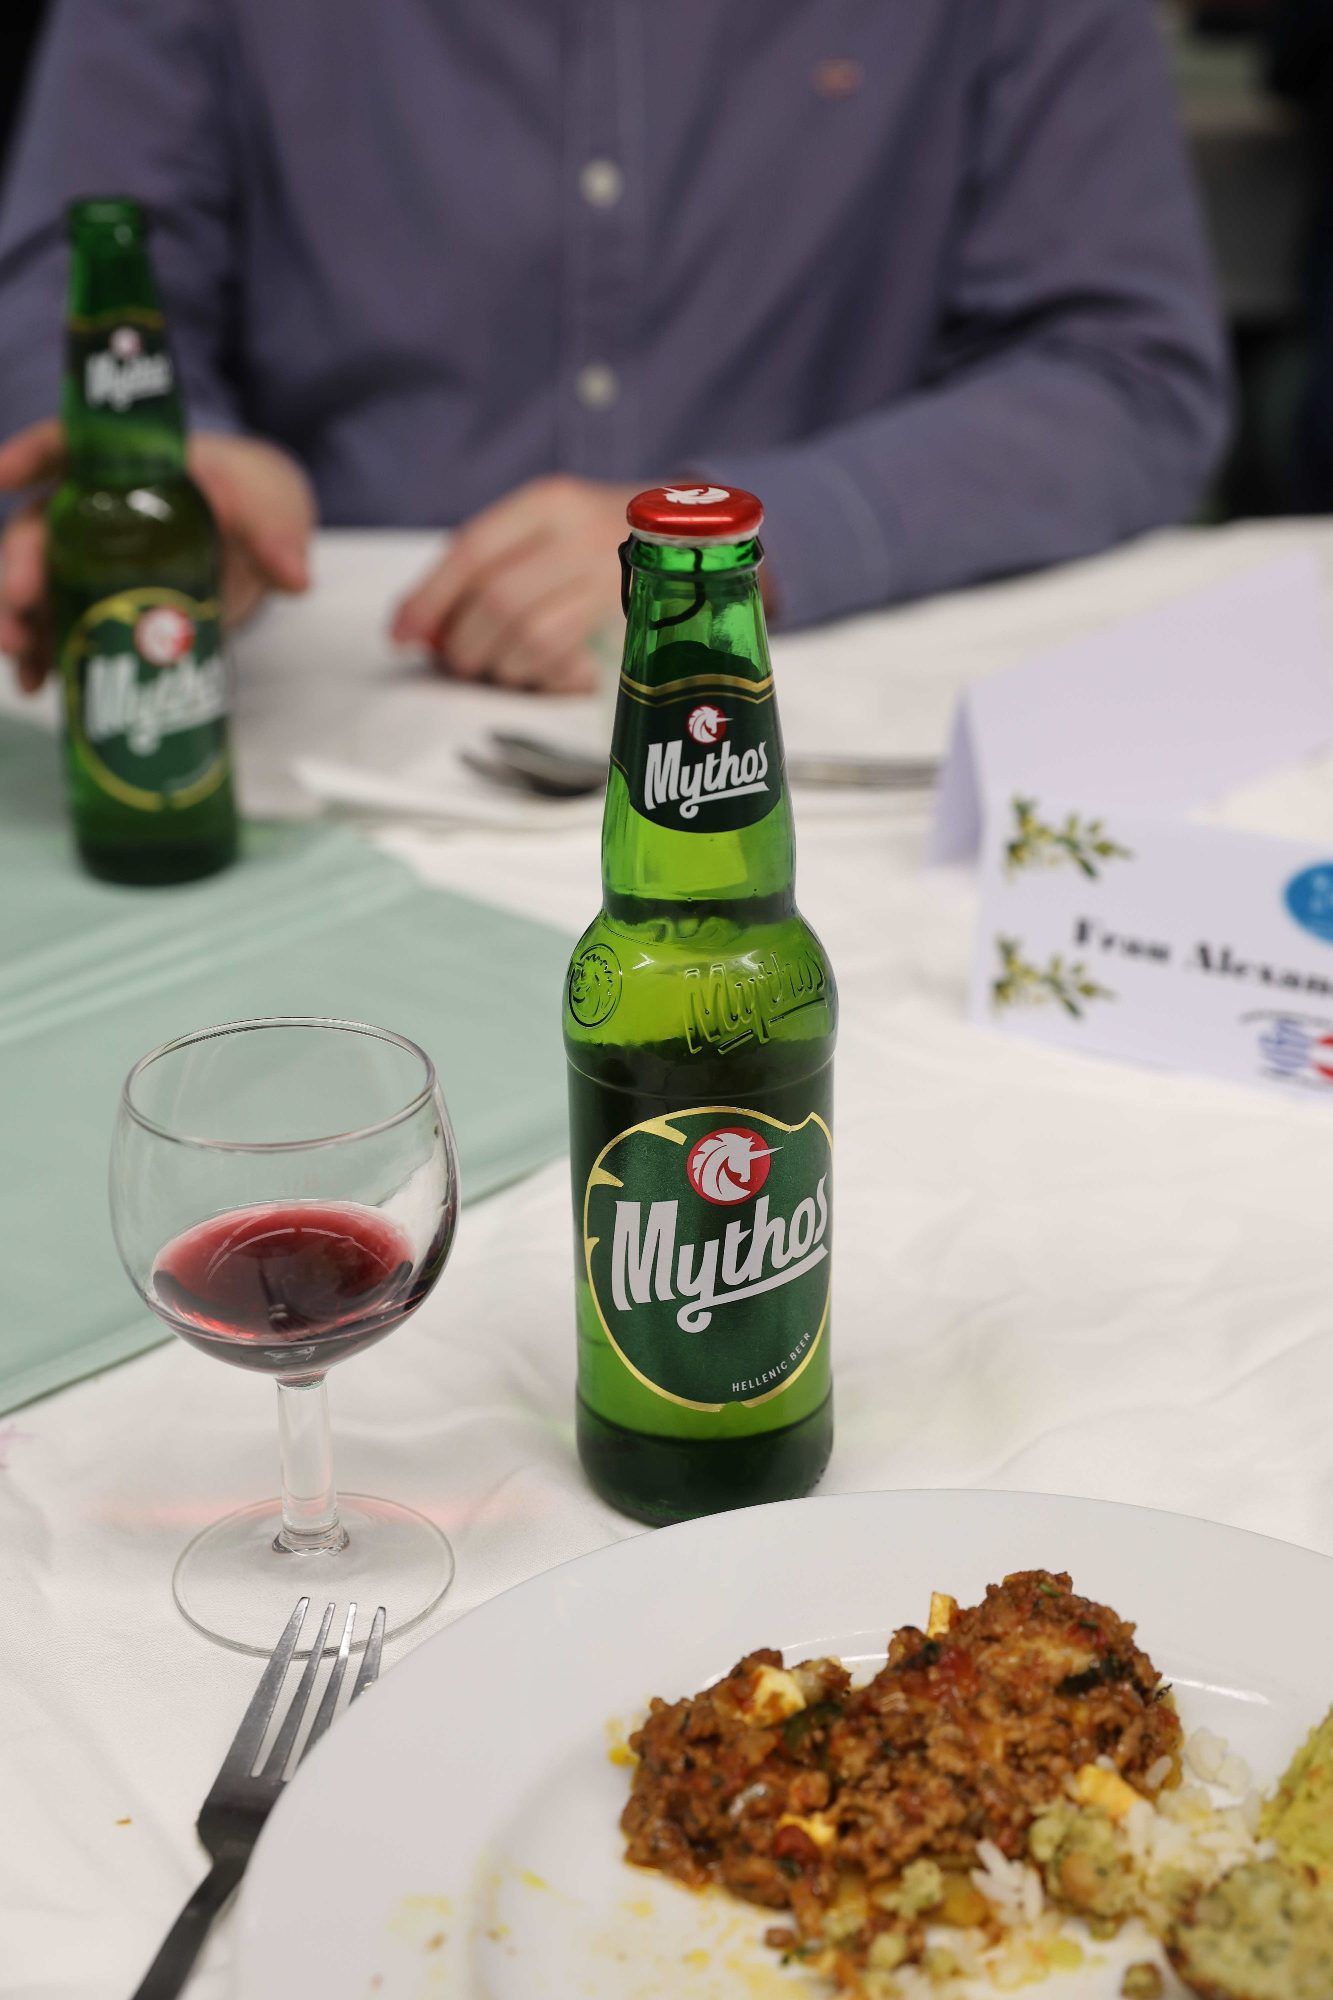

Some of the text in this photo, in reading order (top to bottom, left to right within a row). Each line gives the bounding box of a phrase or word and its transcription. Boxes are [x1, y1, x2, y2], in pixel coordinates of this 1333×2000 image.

[644, 741, 770, 819] Mythos
[611, 1173, 829, 1334] Mythos
[731, 1332, 811, 1393] HELLENIC BEER
